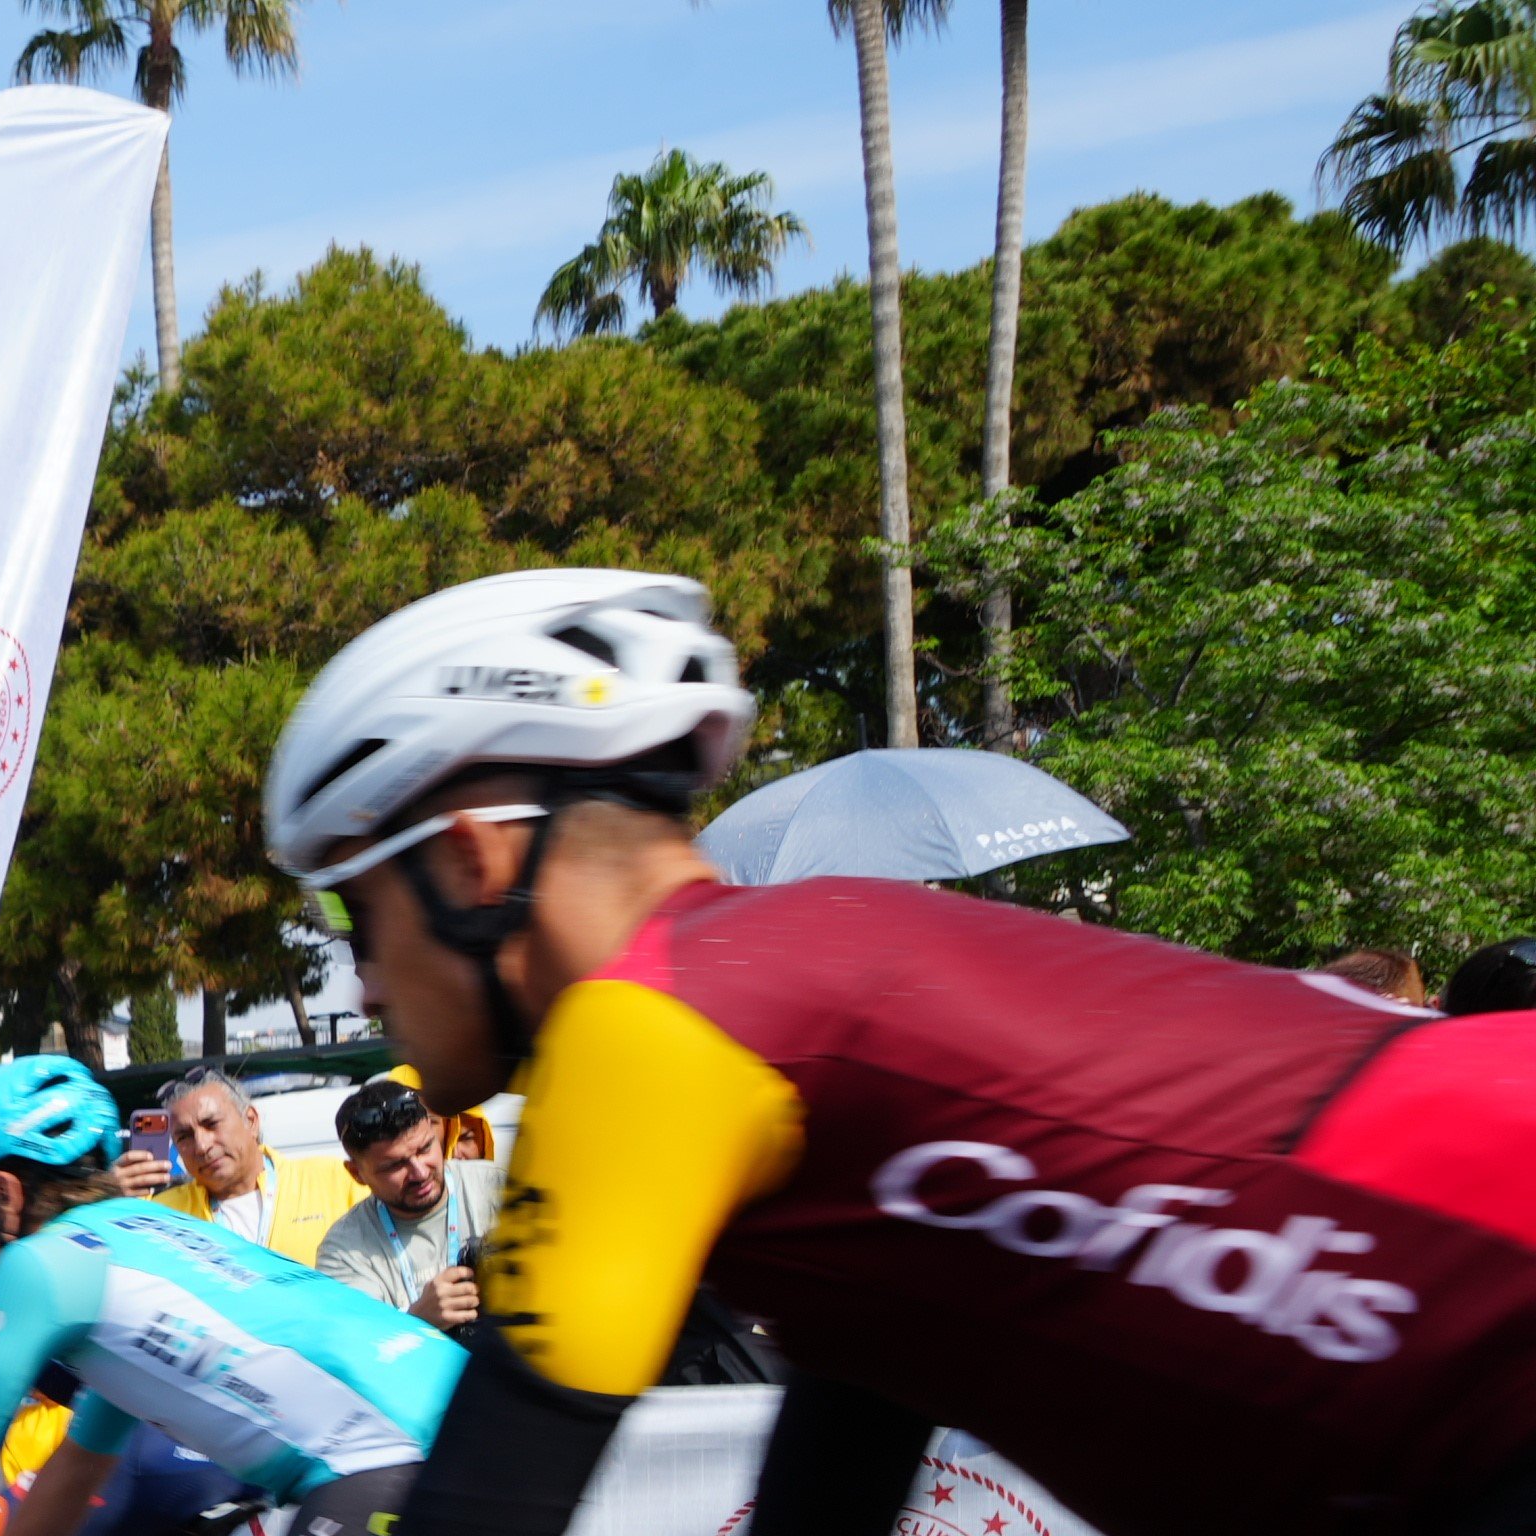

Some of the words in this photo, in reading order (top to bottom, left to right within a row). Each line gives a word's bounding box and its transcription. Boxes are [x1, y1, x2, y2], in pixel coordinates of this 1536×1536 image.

[976, 815, 1078, 849] PALOMA
[989, 829, 1090, 861] HOTELS
[870, 1139, 1419, 1363] Cofidis
